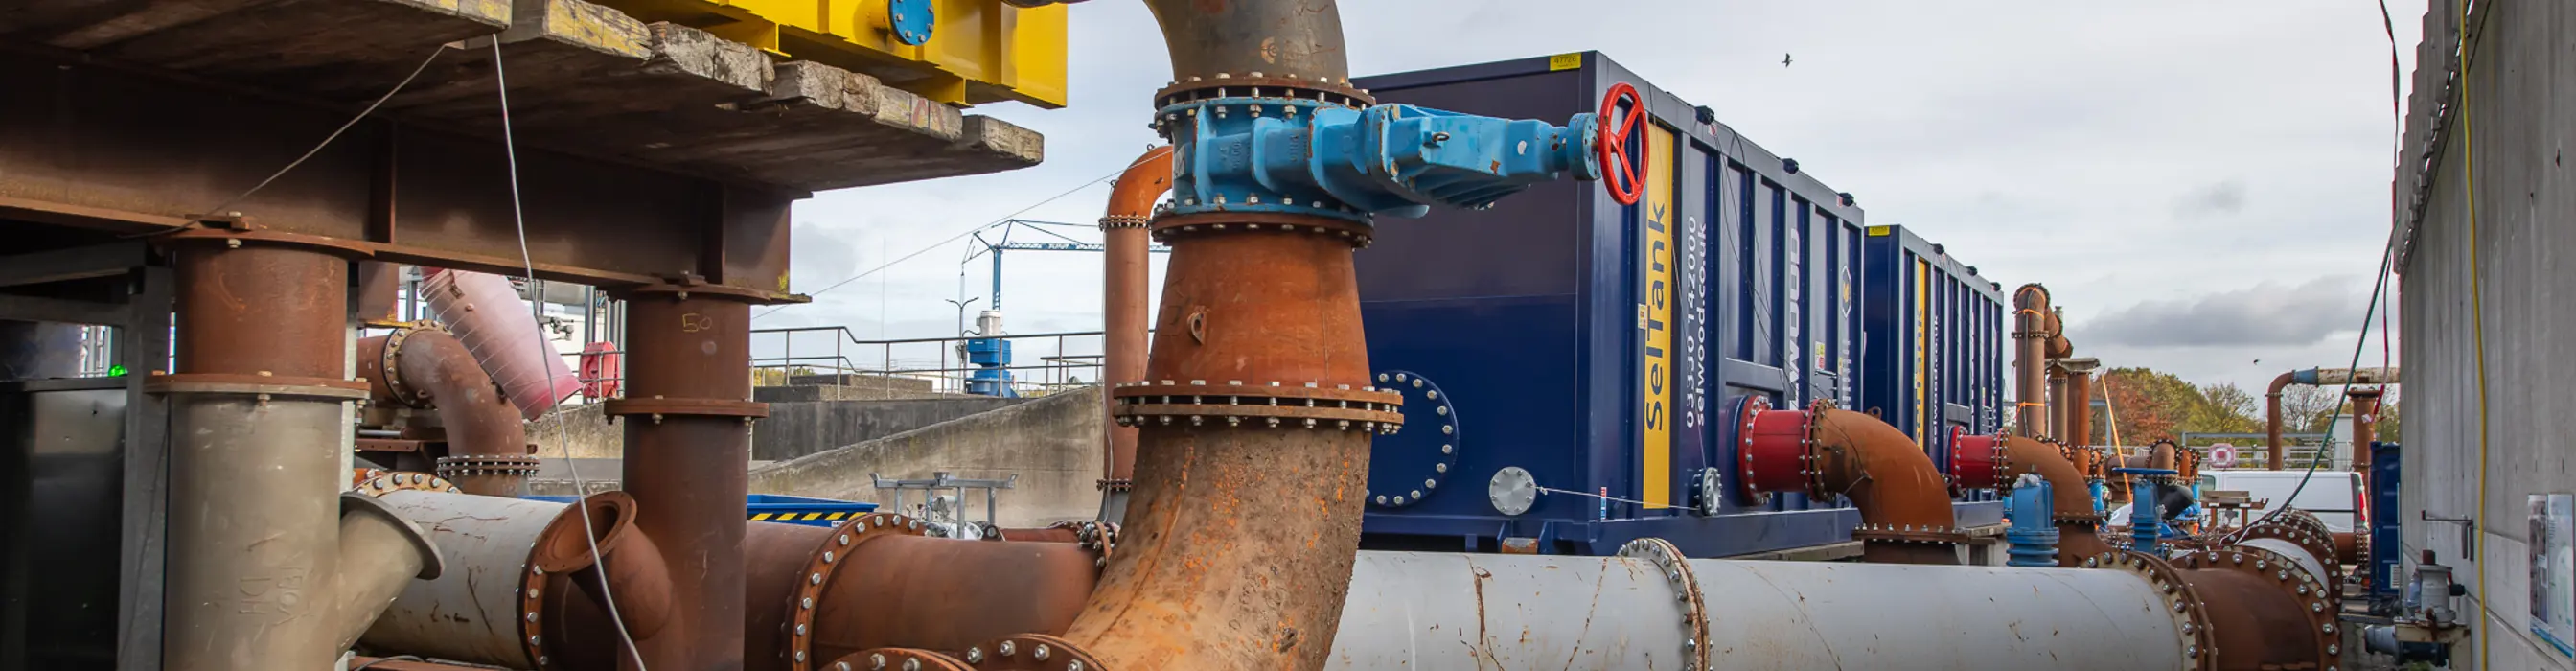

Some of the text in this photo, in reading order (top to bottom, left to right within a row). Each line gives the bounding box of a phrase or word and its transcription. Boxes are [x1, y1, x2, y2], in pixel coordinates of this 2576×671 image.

[682, 312, 713, 333] 50
[1646, 201, 1665, 430] SelTank
[1687, 216, 1696, 428] 03330 142000
[1696, 223, 1707, 427] selwood.co.uk
[1790, 228, 1800, 410] LWOOD
